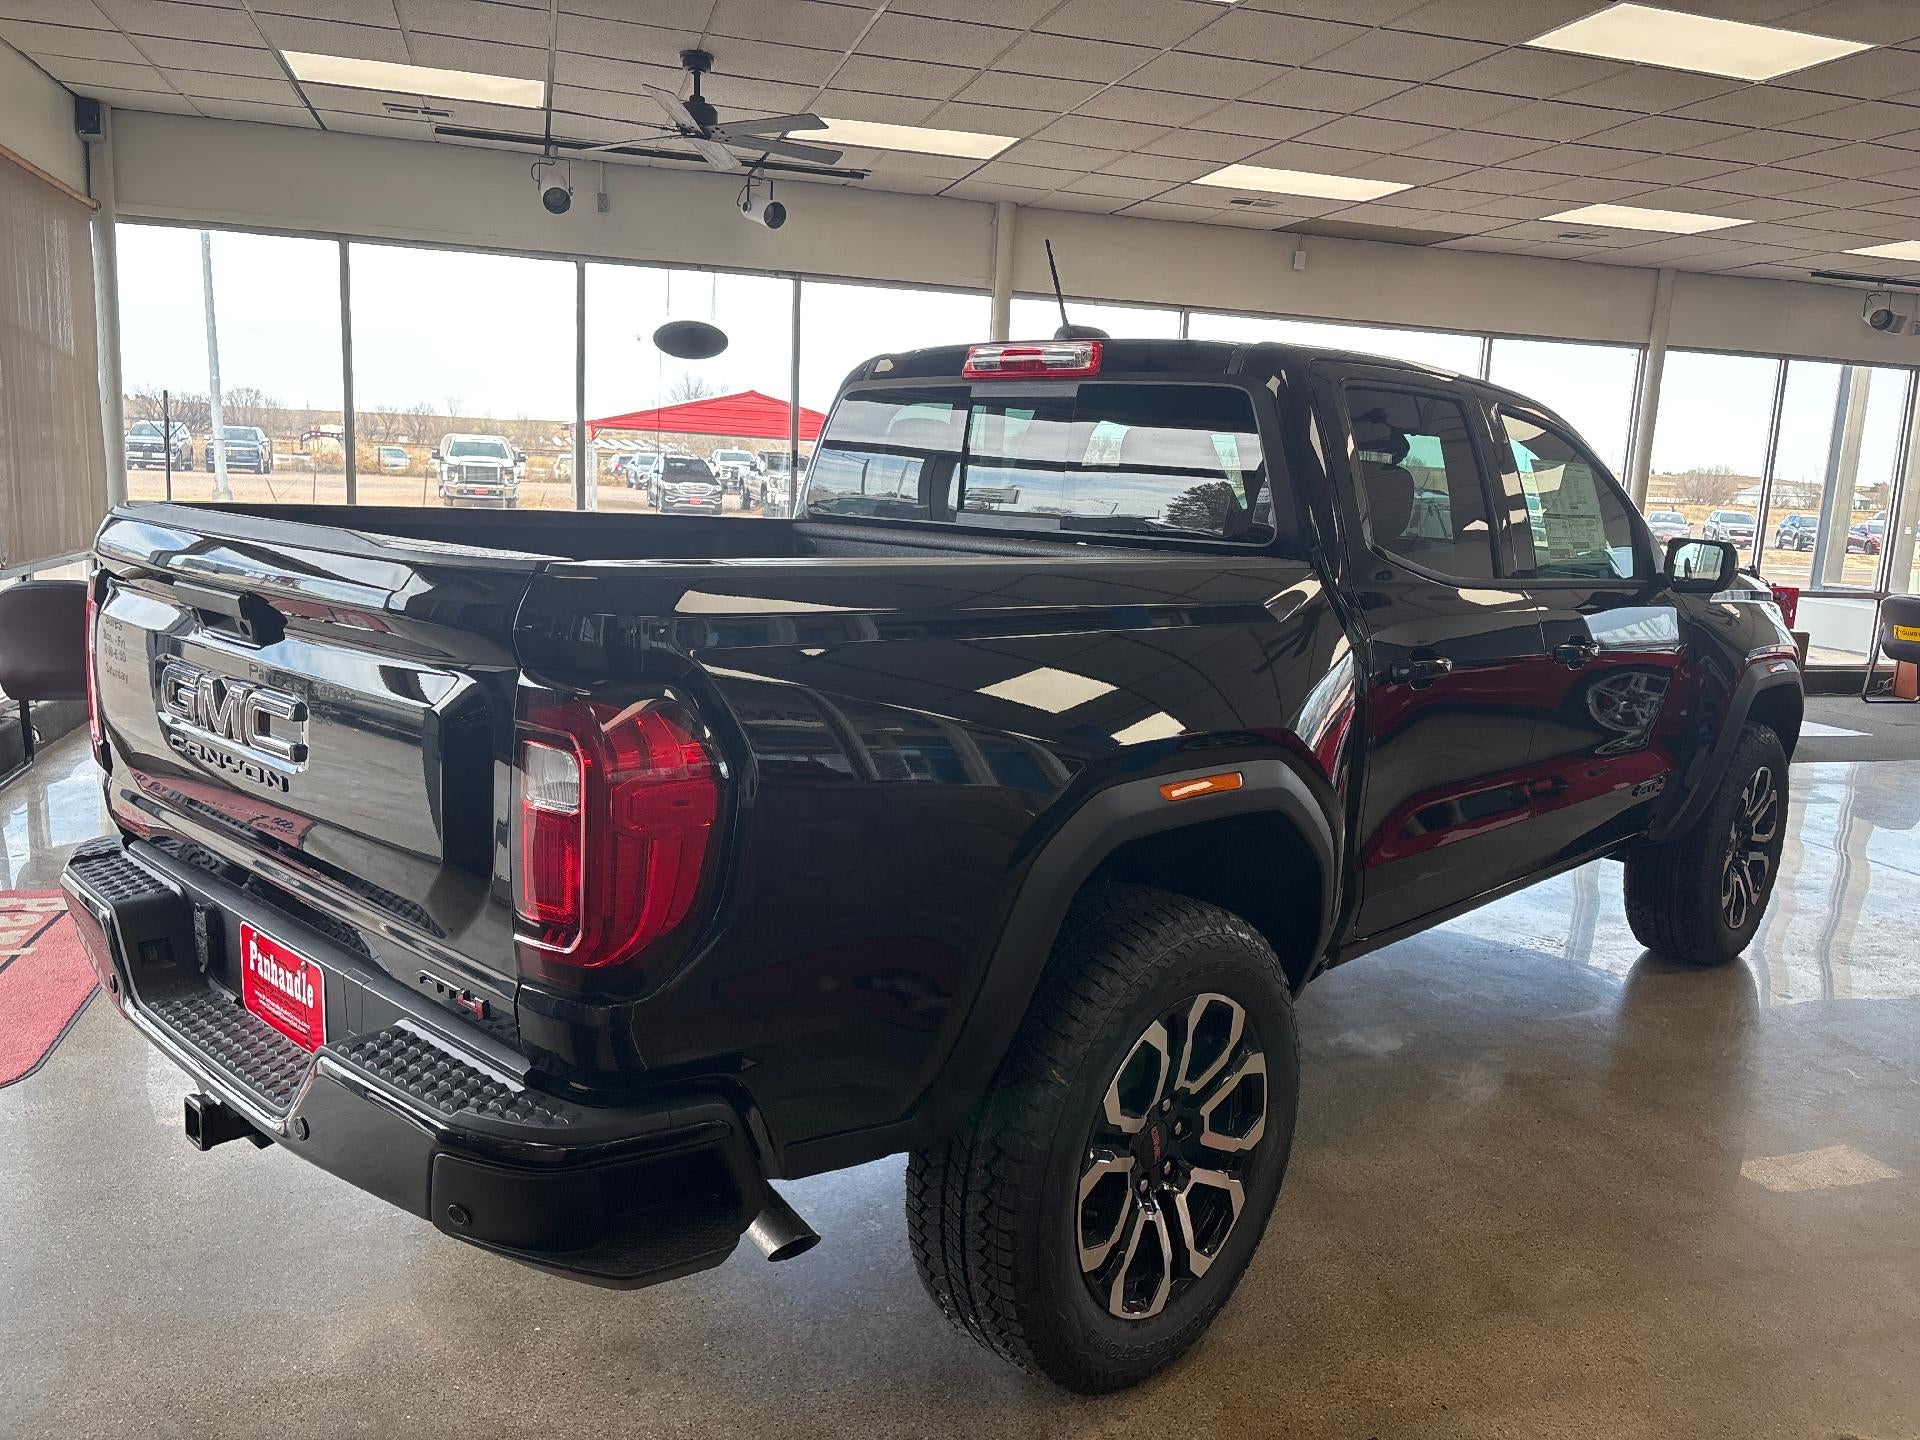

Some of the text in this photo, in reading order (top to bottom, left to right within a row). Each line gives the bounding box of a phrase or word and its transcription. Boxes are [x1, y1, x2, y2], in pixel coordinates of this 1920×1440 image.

[161, 662, 310, 774] GMC
[169, 733, 290, 793] CANYON
[249, 940, 314, 1009] Panhandle
